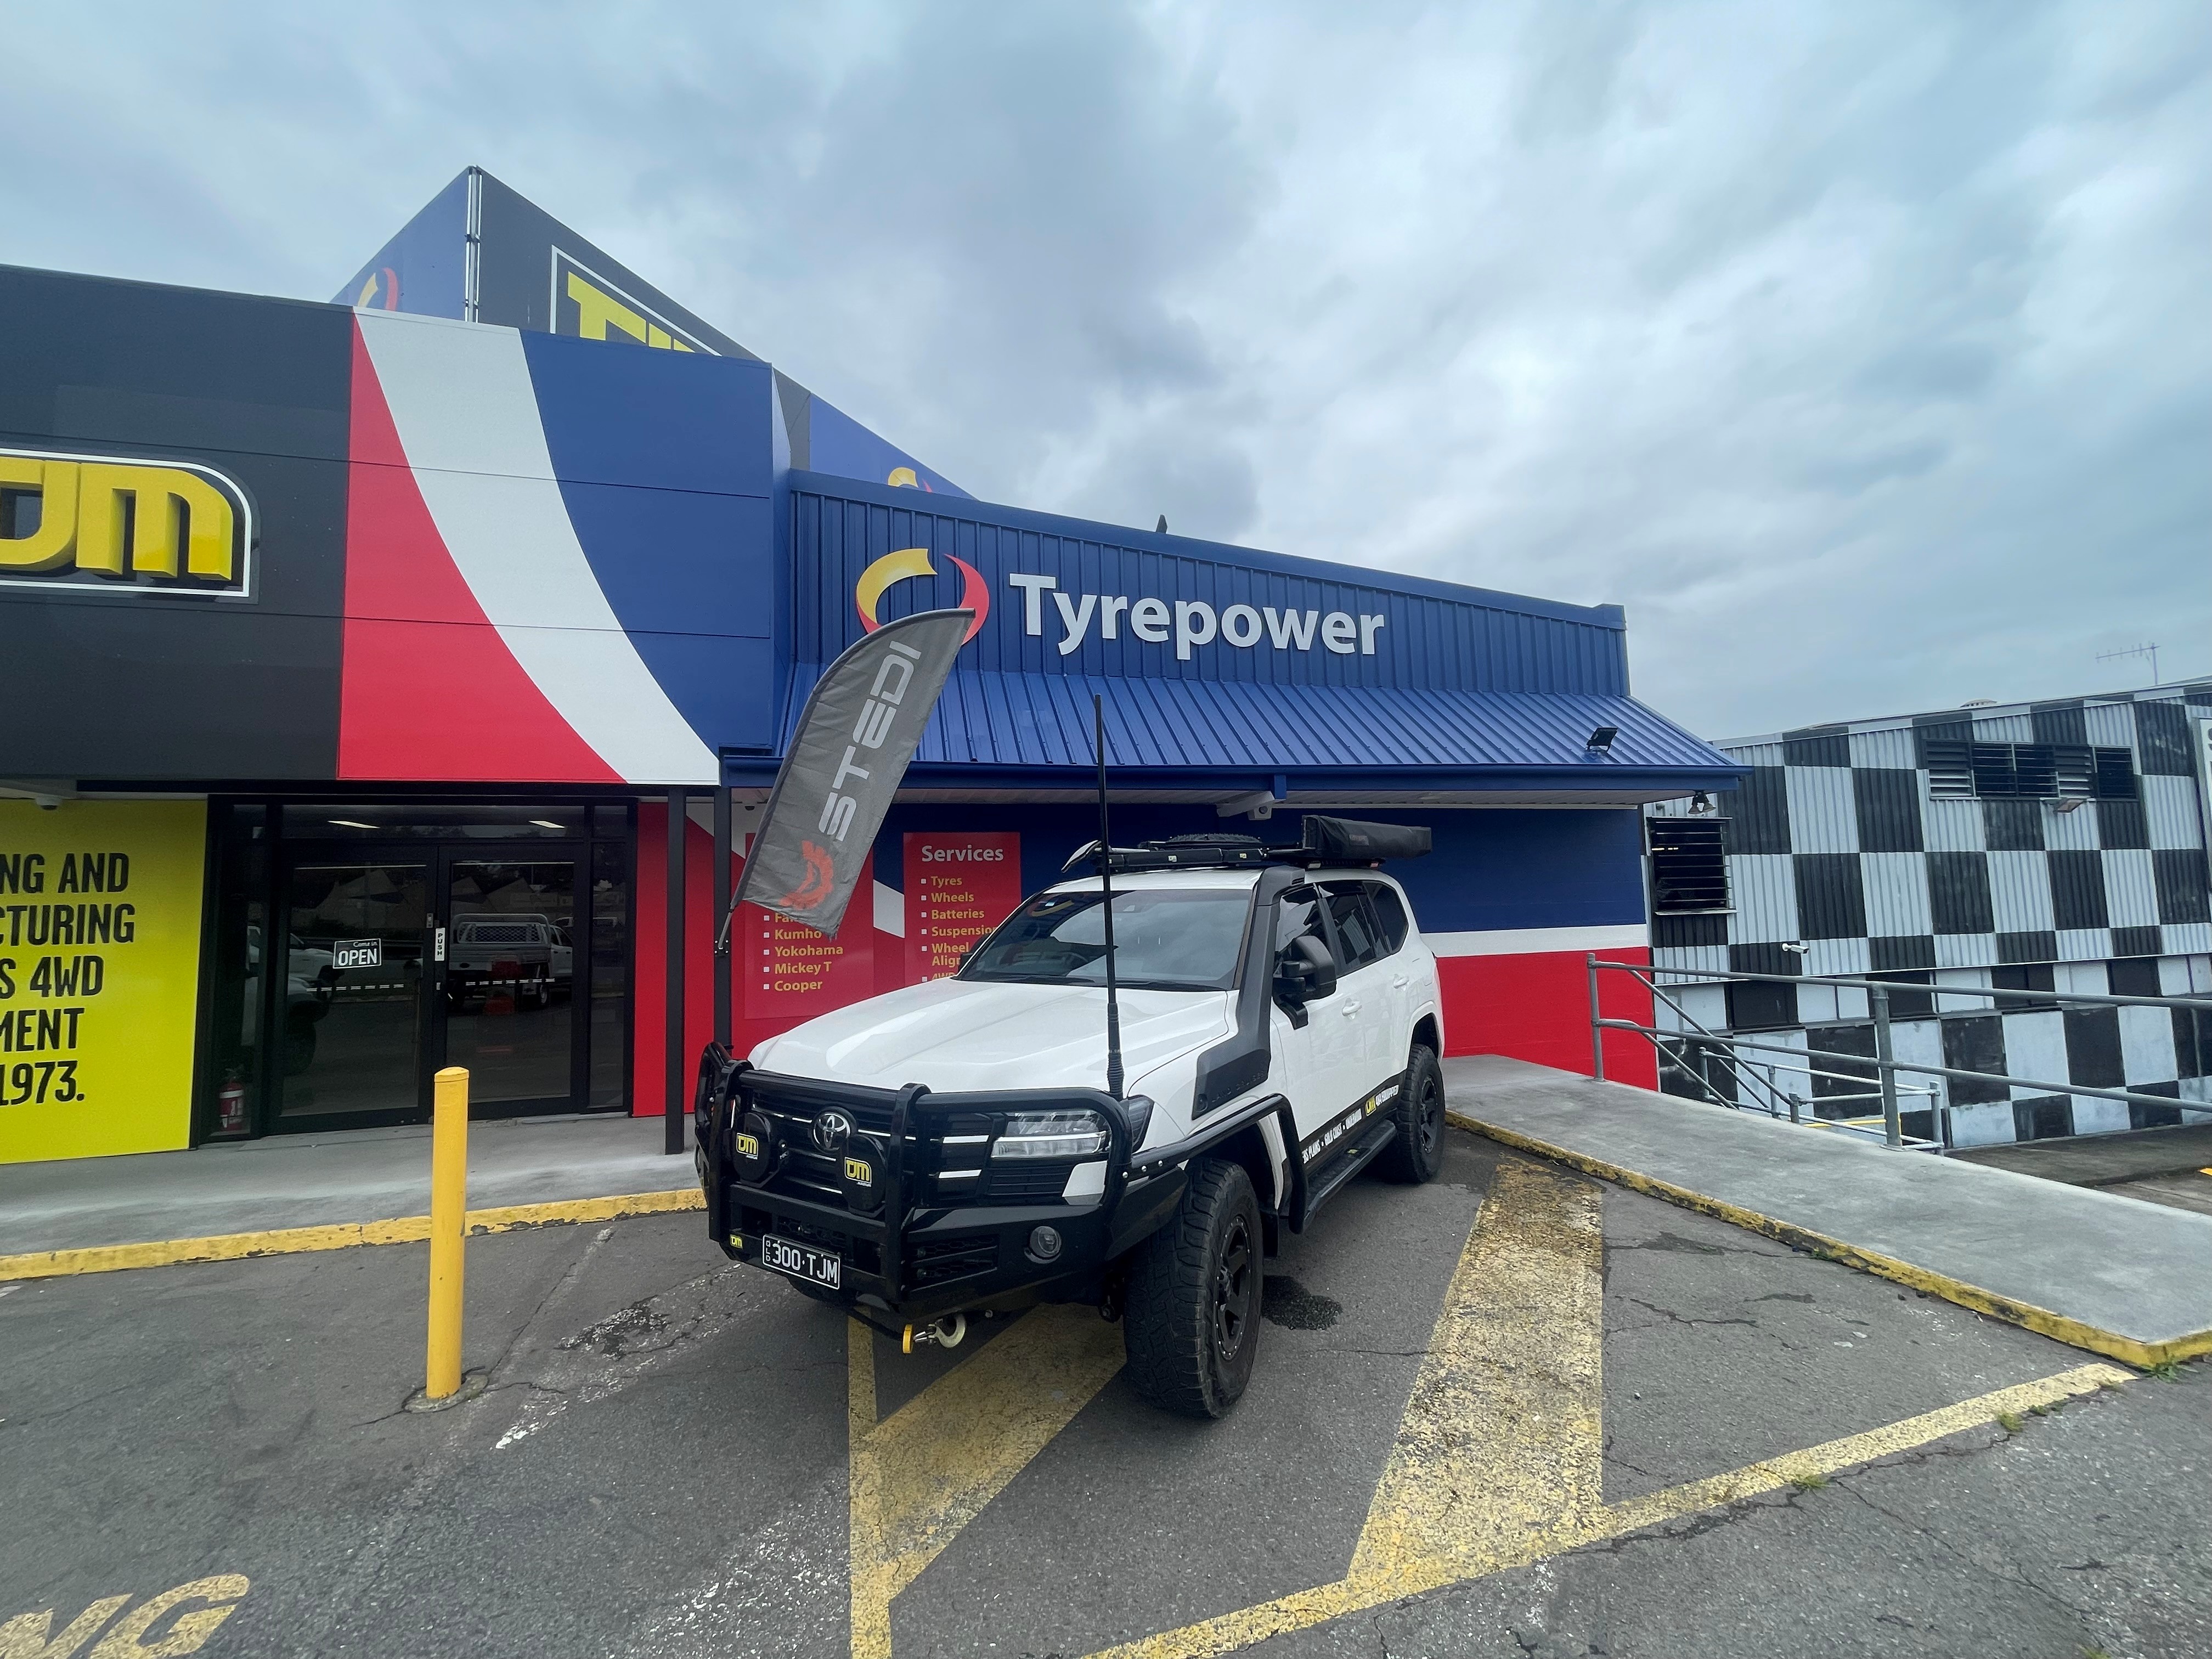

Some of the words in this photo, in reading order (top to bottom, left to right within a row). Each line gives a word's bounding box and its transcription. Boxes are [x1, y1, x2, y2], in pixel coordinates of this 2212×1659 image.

[1009, 573, 1385, 661] Tyrepower
[819, 641, 922, 842] STEDI
[921, 844, 1004, 862] Services
[58, 853, 129, 894] AND
[930, 876, 962, 888] Tyres
[931, 891, 974, 902] Wheels
[932, 909, 985, 919] Batteries
[0, 904, 136, 946] TURING
[775, 928, 822, 940] Kumho
[775, 945, 843, 957] Yokohama
[932, 942, 969, 953] Wheel
[338, 948, 377, 966] OPEN
[775, 962, 821, 975] Mickey
[823, 961, 832, 972] T
[30, 955, 104, 998] 4WD
[774, 980, 823, 993] Cooper
